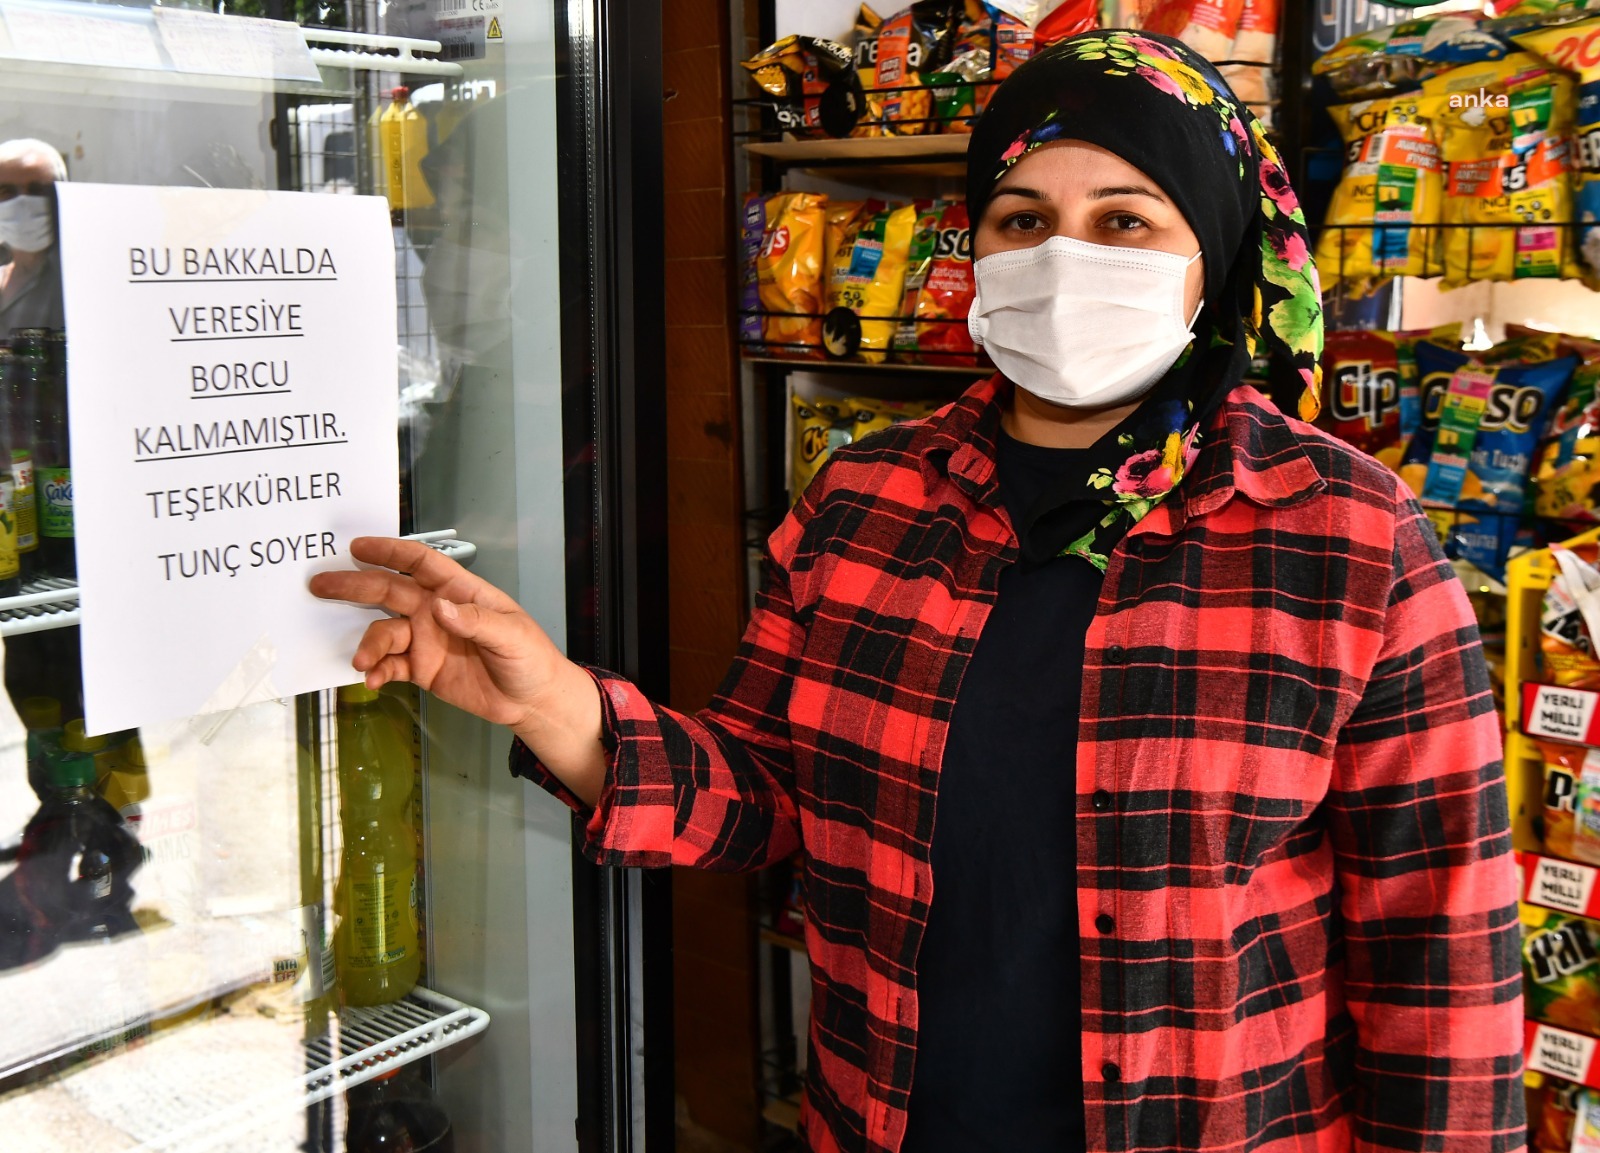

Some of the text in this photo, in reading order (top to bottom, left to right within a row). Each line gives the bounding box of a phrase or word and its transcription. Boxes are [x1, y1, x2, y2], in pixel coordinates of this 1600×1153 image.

[129, 247, 337, 276] BU BAKKALDA
[168, 298, 302, 336] VERESİYE
[190, 360, 289, 393] BORCU
[1331, 361, 1400, 427] Cip
[1421, 372, 1545, 433] Cso
[134, 412, 346, 456] KALMAMIŞTIR.
[146, 472, 342, 522] TEŞEKKÜRLER
[157, 531, 337, 582] TUNÇ SOYER
[1542, 692, 1584, 709] YERLİ
[1542, 863, 1583, 882] YERLİ
[1541, 1032, 1583, 1052] YERLİ
